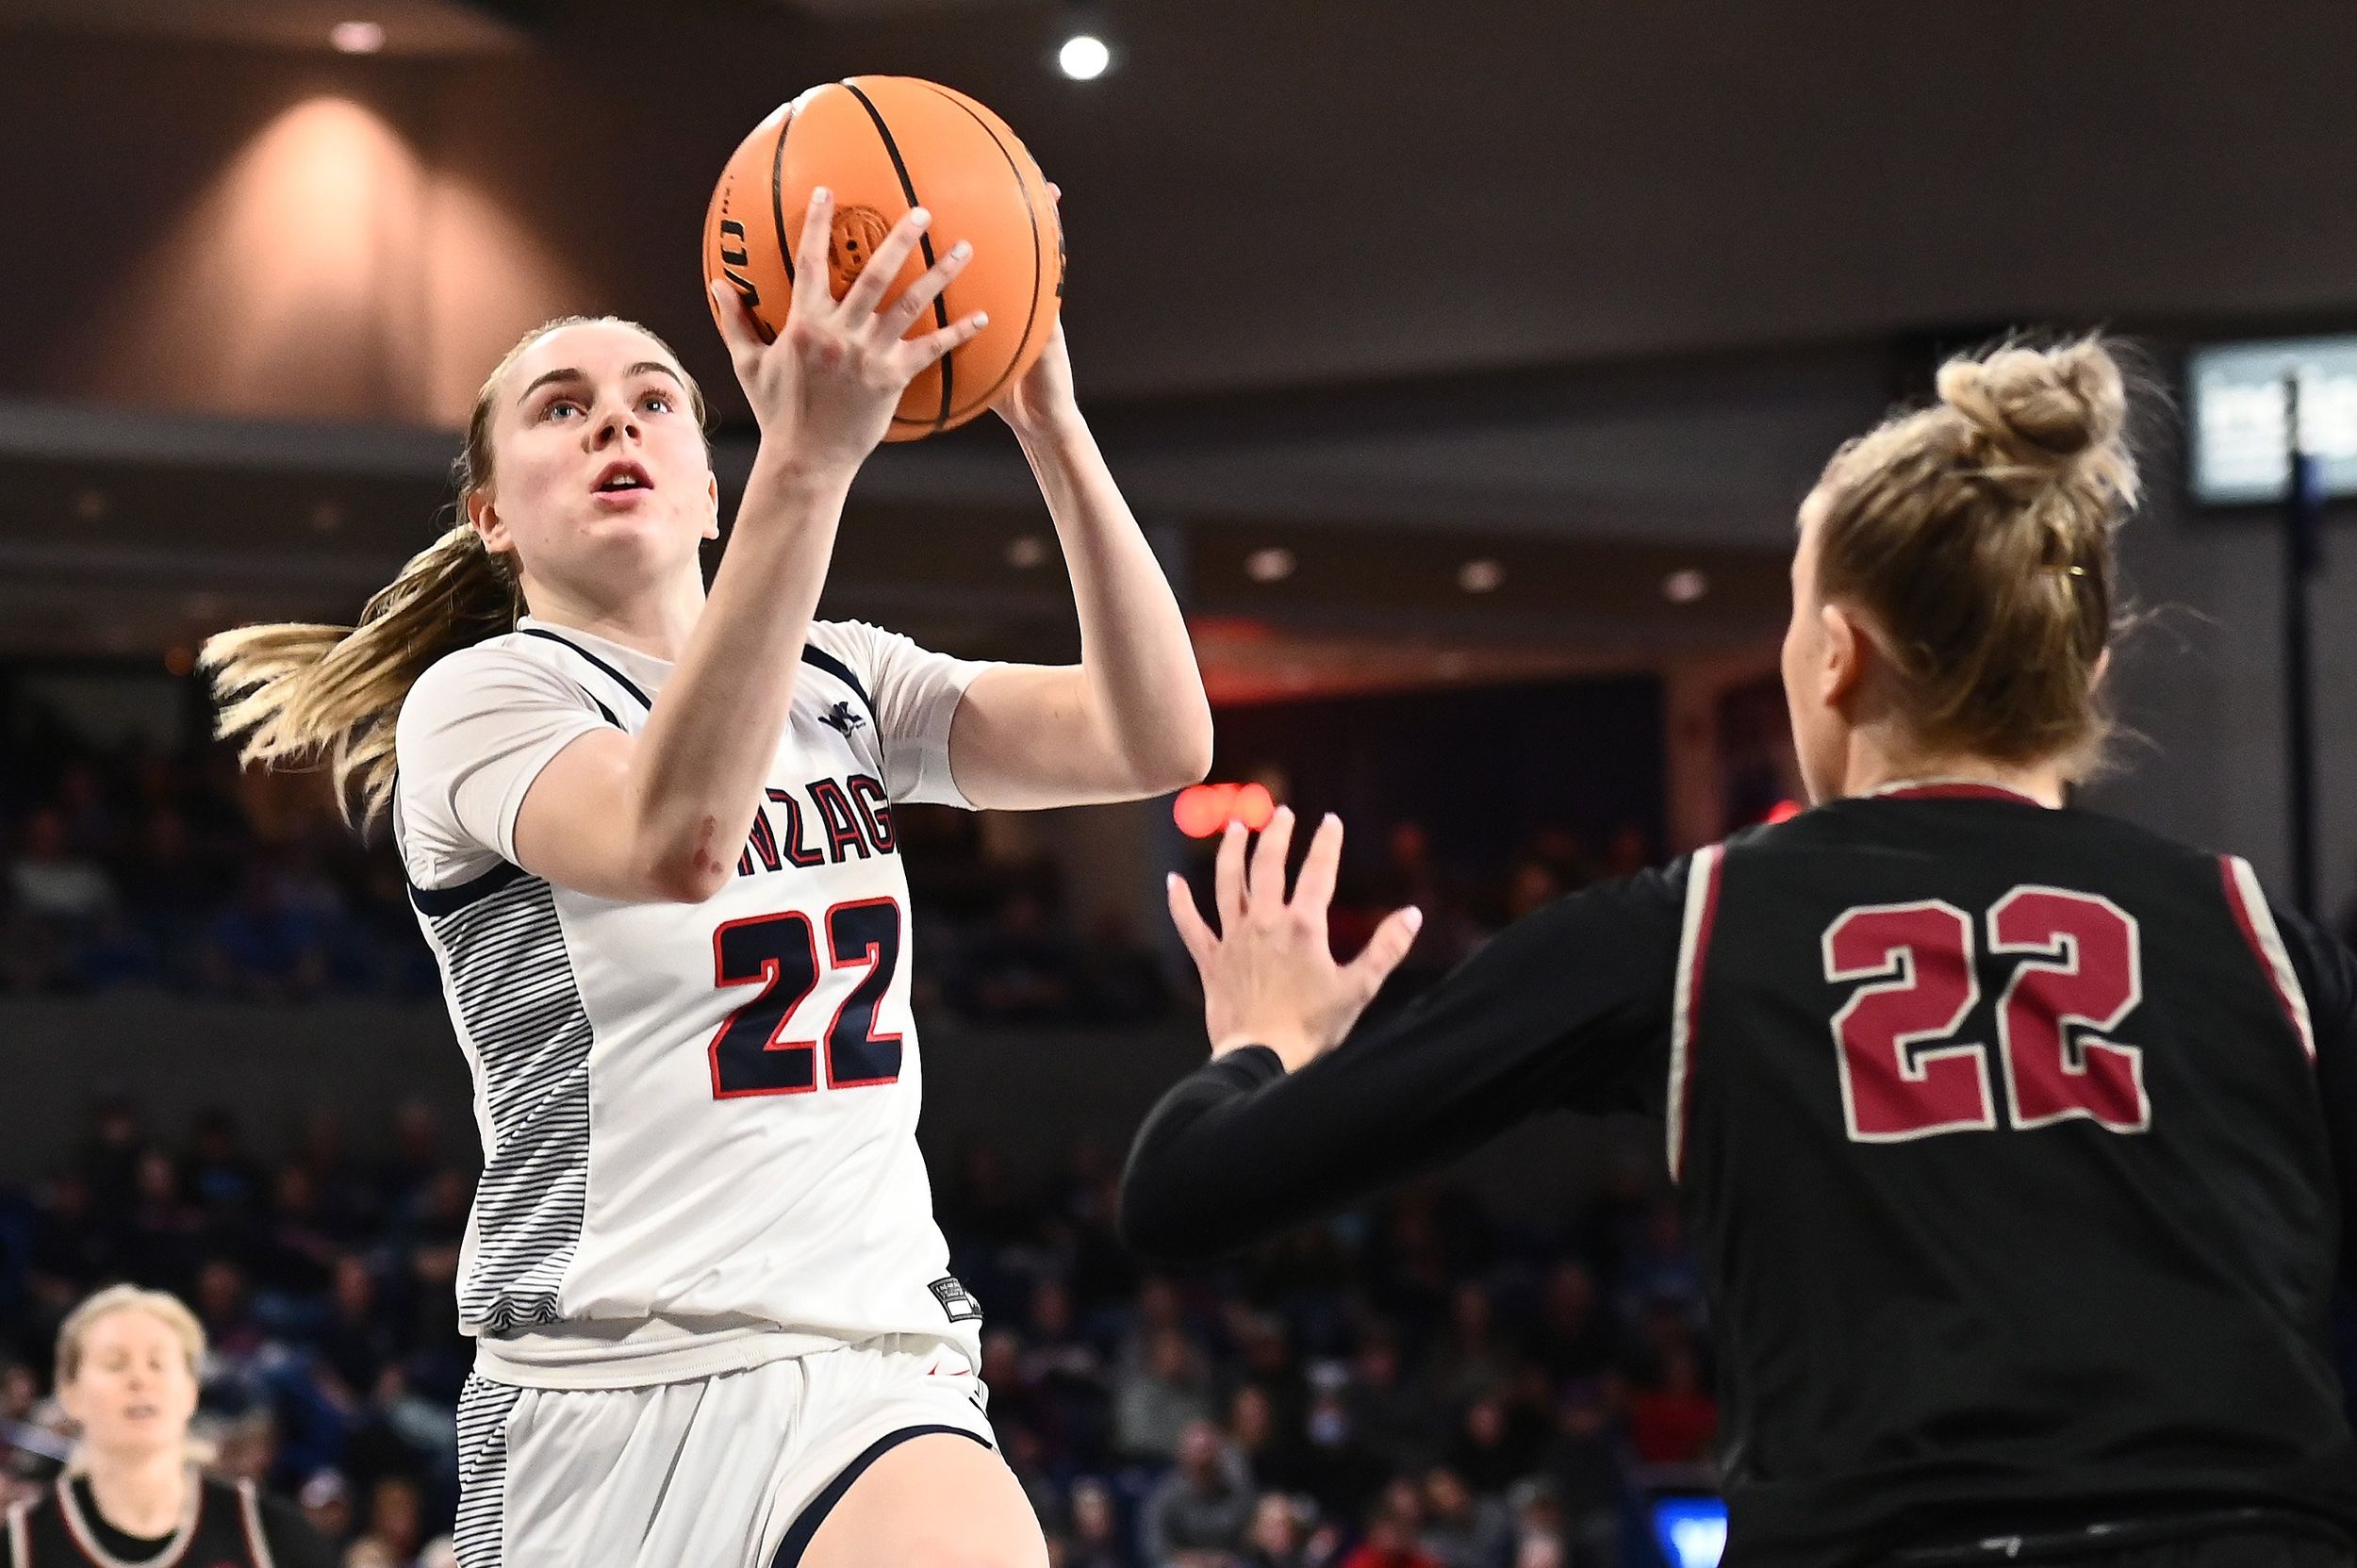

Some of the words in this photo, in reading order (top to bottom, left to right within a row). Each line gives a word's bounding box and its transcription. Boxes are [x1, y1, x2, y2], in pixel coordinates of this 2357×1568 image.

[737, 773, 900, 877] NZAG
[708, 896, 903, 1100] 22
[1821, 883, 2151, 1144] 22
